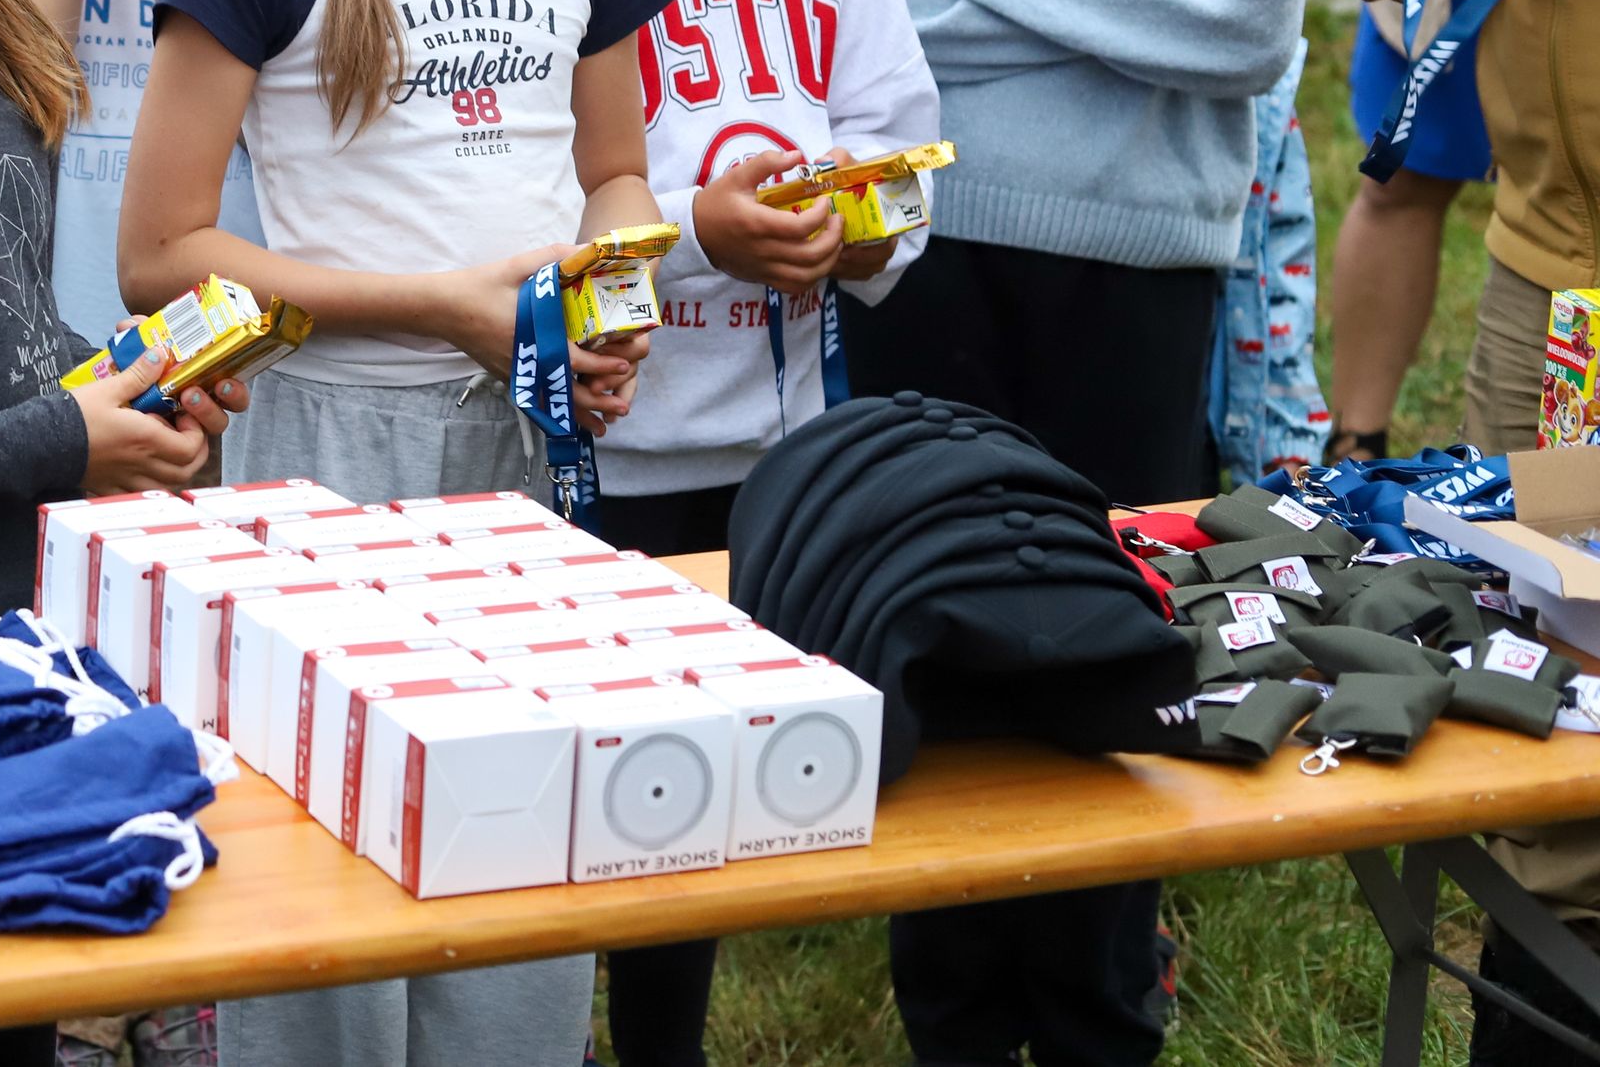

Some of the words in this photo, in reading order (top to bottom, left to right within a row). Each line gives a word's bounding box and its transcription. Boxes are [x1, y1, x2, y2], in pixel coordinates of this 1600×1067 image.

[77, 34, 126, 47] CEAN
[422, 28, 513, 50] ORLANDO
[79, 60, 151, 89] CIFIC
[387, 45, 554, 105] Athletics
[452, 87, 503, 127] 98
[461, 129, 505, 143] STATE
[455, 142, 513, 158] COLLEGE
[661, 300, 706, 328] ALL
[729, 300, 769, 328] STA
[1552, 298, 1574, 316] Hortex
[16, 332, 61, 367] Make
[738, 833, 799, 855] ALARM
[808, 826, 867, 847] SMOKE
[586, 855, 652, 877] ALARM
[655, 849, 719, 871] SMOKE
